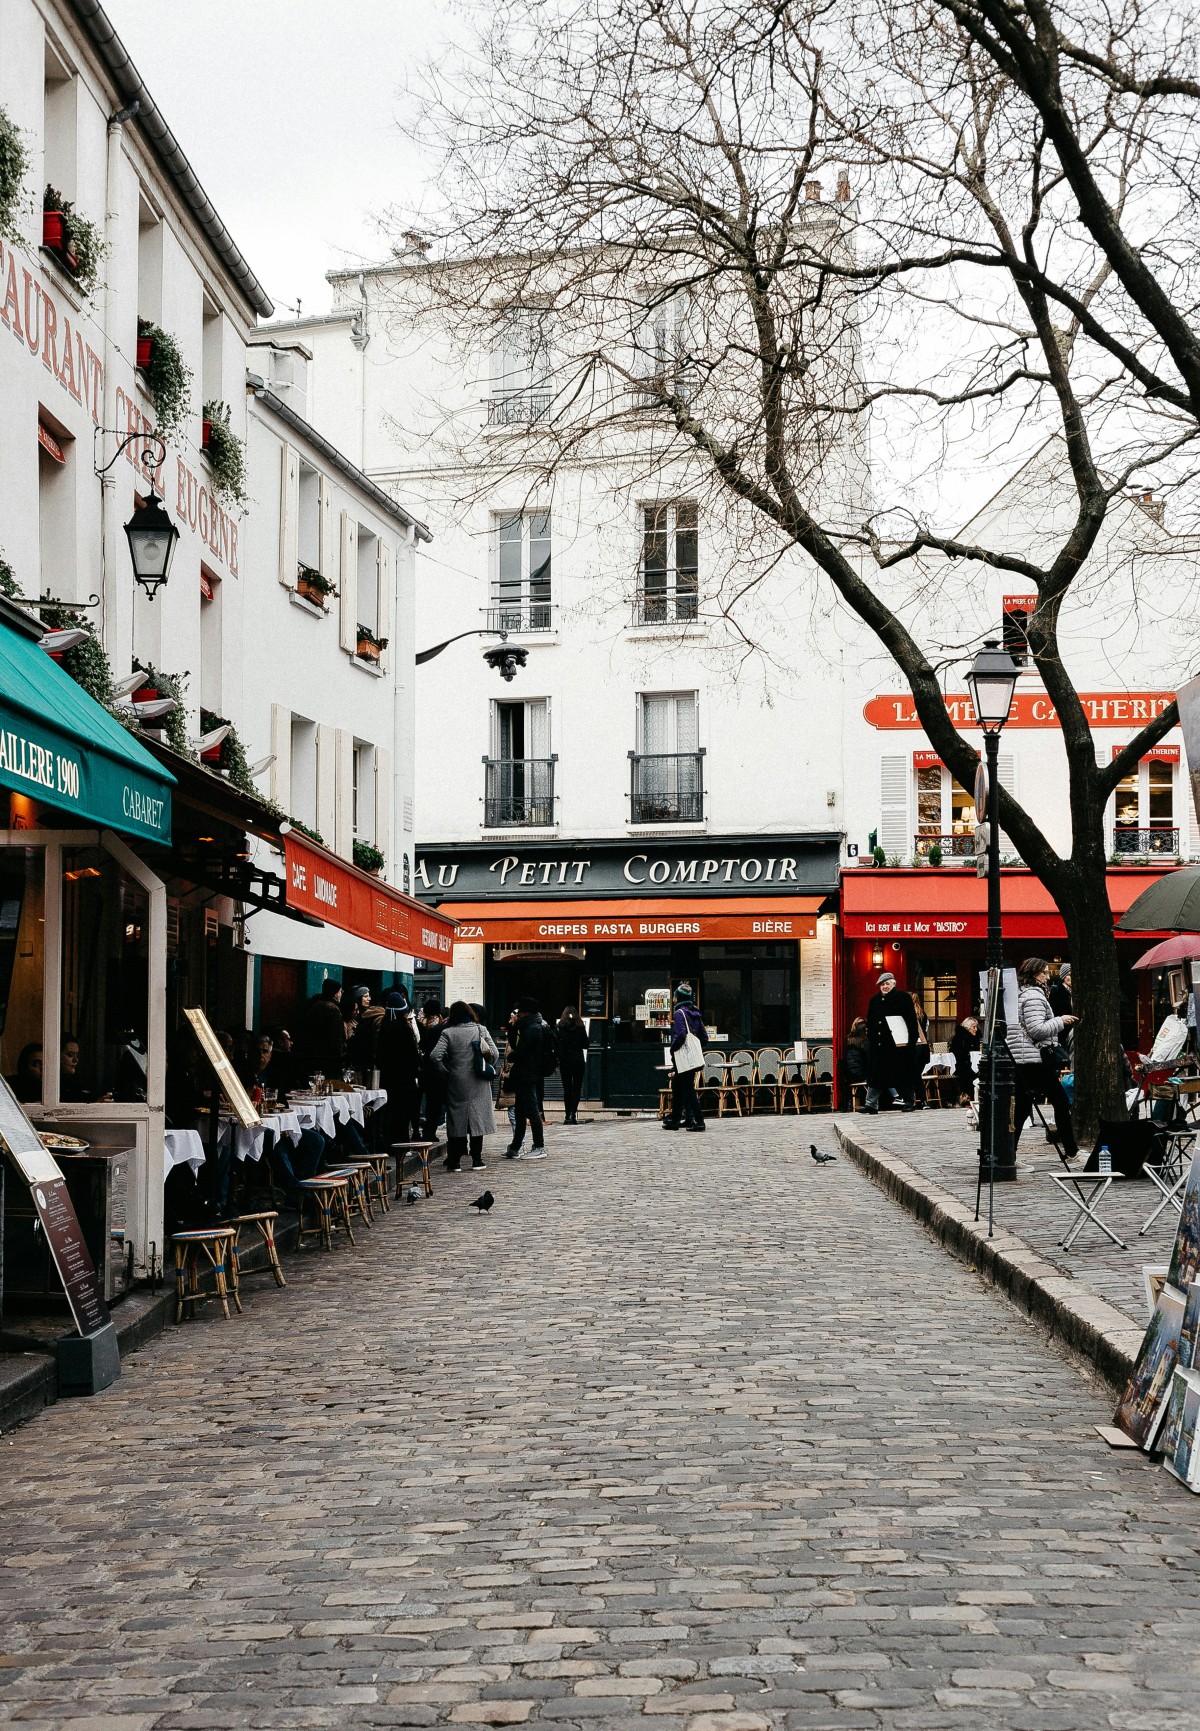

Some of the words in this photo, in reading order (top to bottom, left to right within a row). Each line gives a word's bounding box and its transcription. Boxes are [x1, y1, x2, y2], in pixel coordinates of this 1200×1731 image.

[0, 240, 104, 427] AURANT
[1147, 748, 1180, 756] ATHERINE
[56, 755, 79, 799] 1900
[122, 786, 164, 829] CABARET
[850, 845, 857, 856] 6
[489, 856, 591, 885] PETIT
[623, 854, 798, 884] COMPTOIR
[538, 924, 588, 935] CREPES
[594, 923, 633, 935] PASTA
[639, 922, 701, 934] BURGERS
[752, 919, 793, 933] BIÈRE
[416, 960, 422, 969] 8
